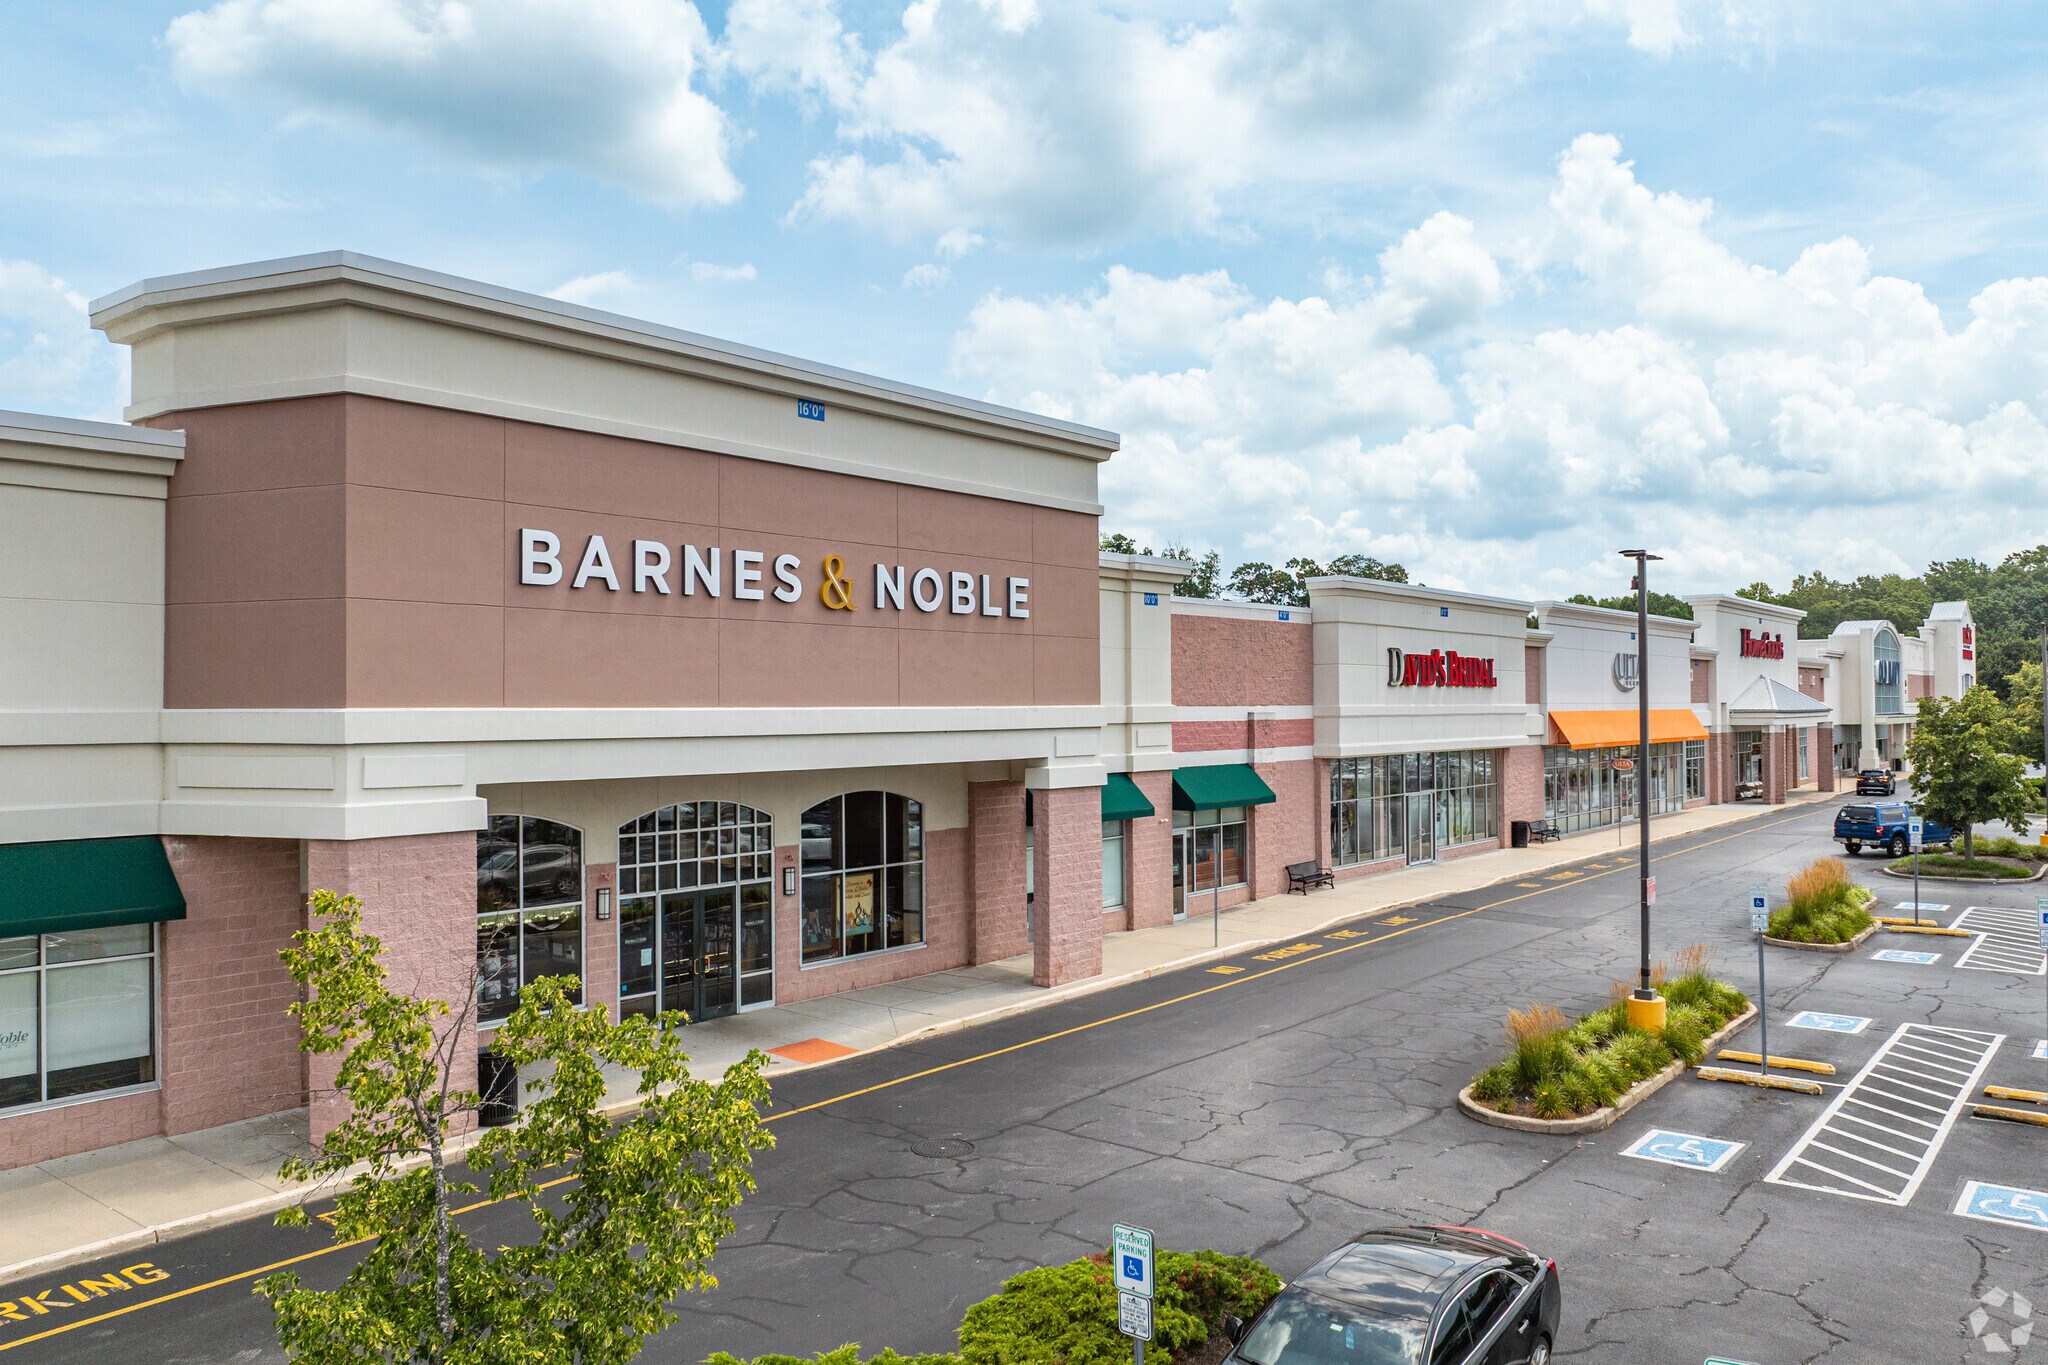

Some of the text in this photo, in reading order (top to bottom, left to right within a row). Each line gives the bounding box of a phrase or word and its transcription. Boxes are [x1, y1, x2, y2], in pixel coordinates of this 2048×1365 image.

[799, 401, 824, 418] 16'0"
[519, 528, 1030, 618] BARNES & NOBLE
[1387, 647, 1497, 687] DAVID'S BRIDAL
[1614, 652, 1640, 680] ULT
[0, 1031, 29, 1044] oble
[1115, 1231, 1149, 1247] RESERVED
[1118, 1242, 1147, 1257] PARKING
